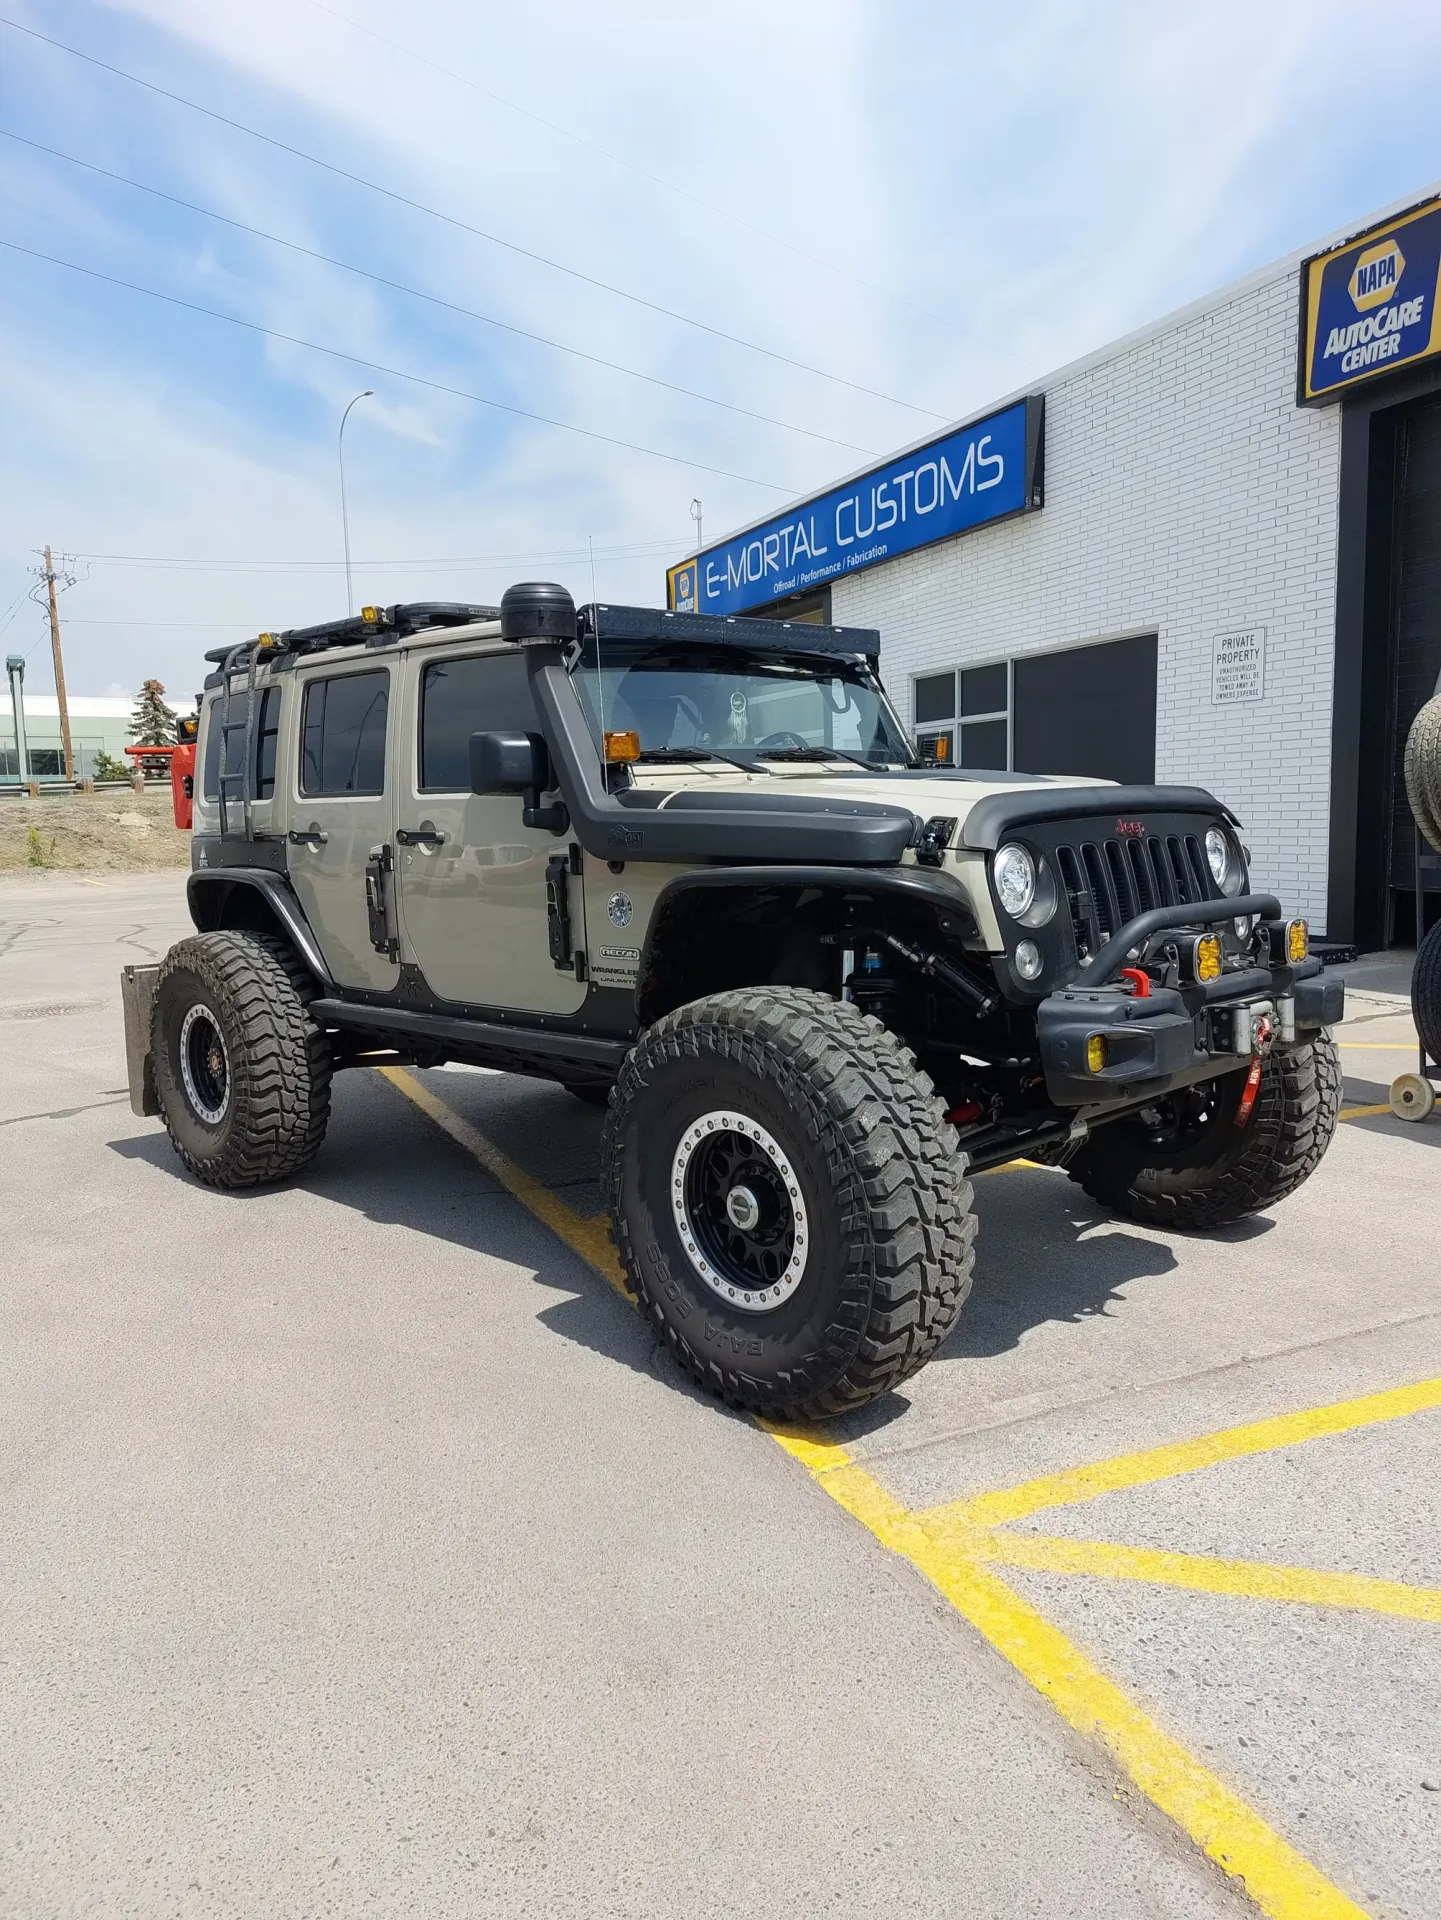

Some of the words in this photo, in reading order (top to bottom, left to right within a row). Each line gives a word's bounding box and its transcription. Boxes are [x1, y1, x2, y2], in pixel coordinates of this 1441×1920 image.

[1356, 255, 1396, 298] NAPA
[1323, 295, 1425, 359] AUTOCARE
[1341, 333, 1401, 374] CENTER
[706, 516, 828, 598] E-MORTAL
[835, 435, 1004, 545] CUSTOMS
[773, 578, 796, 593] Offroad
[800, 562, 841, 585] Performance
[846, 544, 888, 567] Fabrication
[1222, 634, 1255, 650] PRIVATE
[1216, 648, 1260, 665] PROPERTY
[1220, 664, 1256, 674] UNAUTHORIZED
[1216, 674, 1239, 683] VEHICLES
[1219, 683, 1234, 691] TOWED
[1237, 689, 1258, 697] EXPENSE
[1115, 818, 1145, 838] Jeep
[602, 949, 637, 957] RECON
[591, 966, 639, 977] WRANGLER
[646, 1242, 694, 1320] BOSS
[704, 1321, 764, 1356] BAJA
